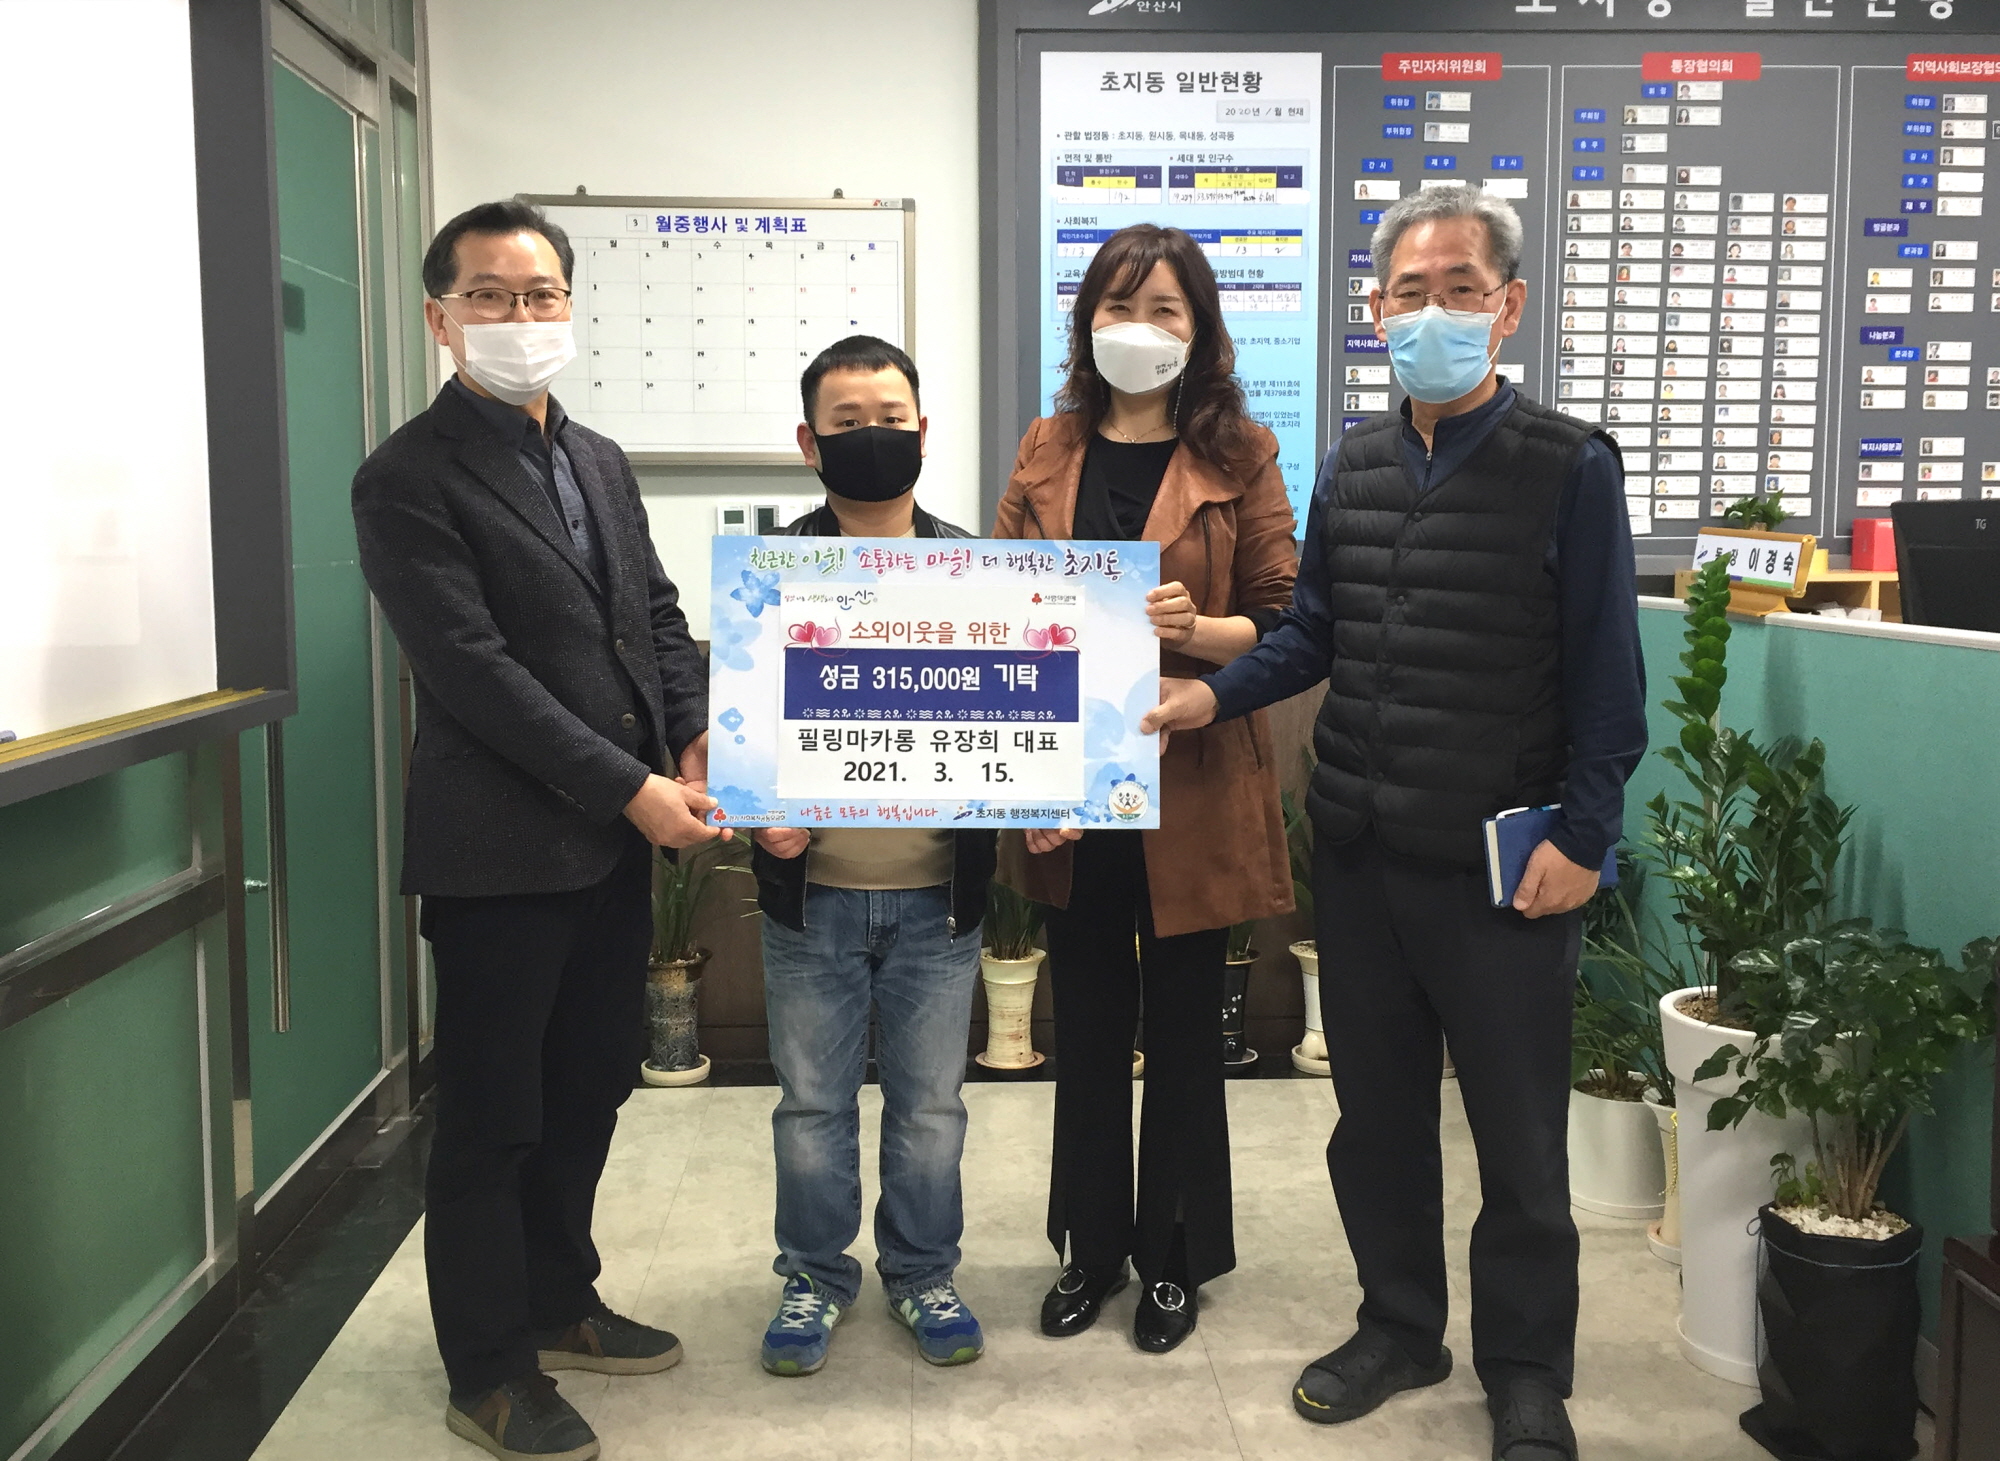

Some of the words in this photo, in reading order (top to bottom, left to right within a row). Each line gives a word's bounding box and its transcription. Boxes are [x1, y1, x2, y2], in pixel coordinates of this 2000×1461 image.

[1136, 1, 1181, 12] 안산시
[1398, 60, 1486, 73] 주민자치위원회
[1671, 59, 1733, 74] 통장협의회
[1100, 72, 1165, 93] 초지동
[1176, 71, 1262, 94] 일반현황
[1390, 98, 1409, 106] 위원장
[1912, 98, 1930, 106] 위원장
[1064, 131, 1080, 140] 관할
[1084, 131, 1108, 140] 법정동
[1210, 131, 1235, 140] 성곡동
[1386, 127, 1411, 135] 부위원장
[1907, 126, 1931, 134] 부위원장
[1064, 154, 1081, 162] 면적
[1084, 154, 1092, 162] 및
[1177, 154, 1194, 163] 세대
[1198, 154, 1205, 163] 및
[1208, 154, 1234, 163] 인구수
[656, 215, 727, 233] 월중행사
[735, 218, 748, 232] 및
[755, 216, 807, 234] 계획표
[1064, 217, 1097, 226] 사회복지
[610, 240, 617, 248] 월
[766, 242, 773, 250] 목
[817, 242, 824, 250] 금
[1248, 269, 1264, 278] 현황
[1975, 518, 1986, 530] TG
[751, 548, 795, 569] 친근한
[802, 547, 844, 574] 이웃!
[859, 549, 915, 574] 소통하는
[927, 548, 970, 576] 마을!
[982, 555, 998, 567] 더
[1006, 552, 1054, 575] 행복한
[1064, 549, 1122, 580] 초지동
[849, 621, 956, 644] 소외이웃을
[967, 622, 1010, 644] 위한
[819, 665, 860, 691] 성금
[872, 666, 980, 693] 315,000원
[994, 664, 1039, 692] 기탁
[798, 728, 916, 752] 필링마카롱
[930, 729, 998, 753] 유장희
[1014, 730, 1059, 753] 대표
[844, 761, 907, 782] 2021.
[934, 762, 953, 782] 3.
[982, 762, 1014, 783] 15.
[800, 805, 832, 821] 나눔은
[839, 807, 869, 820] 모두의
[976, 808, 1006, 819] 초지동
[1010, 808, 1070, 819] 행정복지센터
